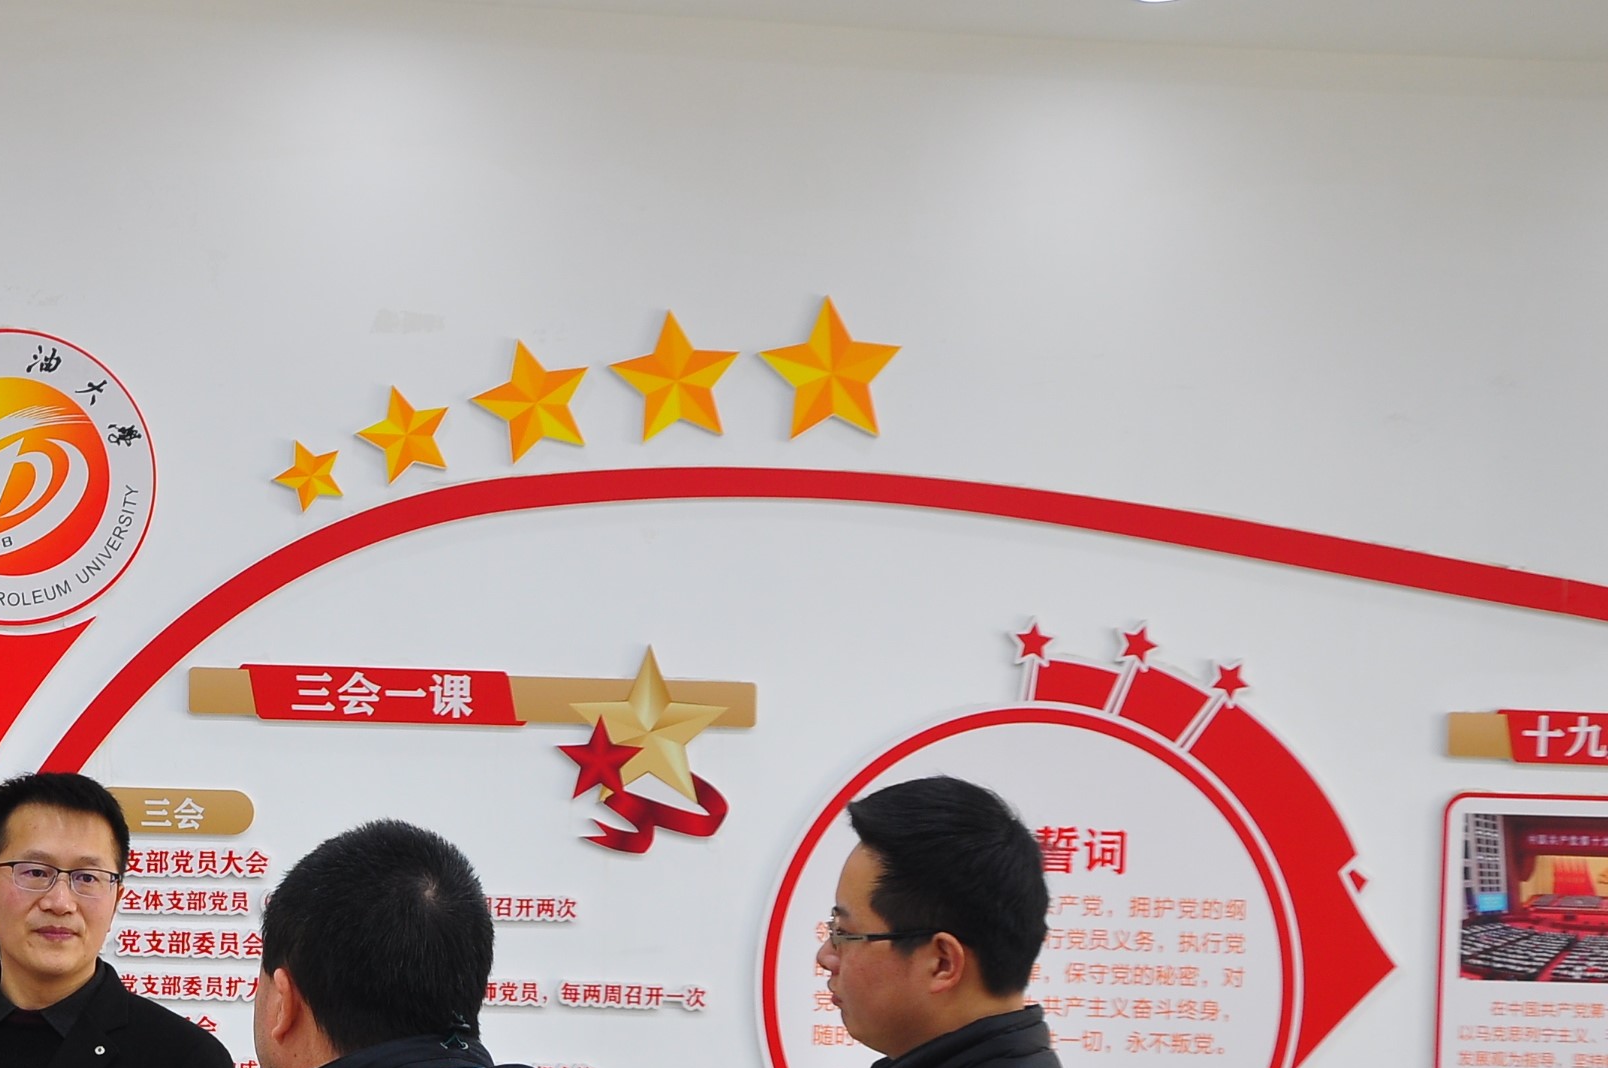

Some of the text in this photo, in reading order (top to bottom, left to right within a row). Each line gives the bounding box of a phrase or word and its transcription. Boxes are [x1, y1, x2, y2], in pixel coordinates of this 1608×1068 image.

[75, 484, 139, 585] UNIVERSITY
[291, 671, 474, 719] 三会一课
[1521, 714, 1608, 759] 十九
[140, 797, 205, 831] 三会
[1035, 825, 1129, 876] 誓词
[117, 929, 264, 957] 党支部委员会
[1491, 1000, 1608, 1019] 在中国共产党第
